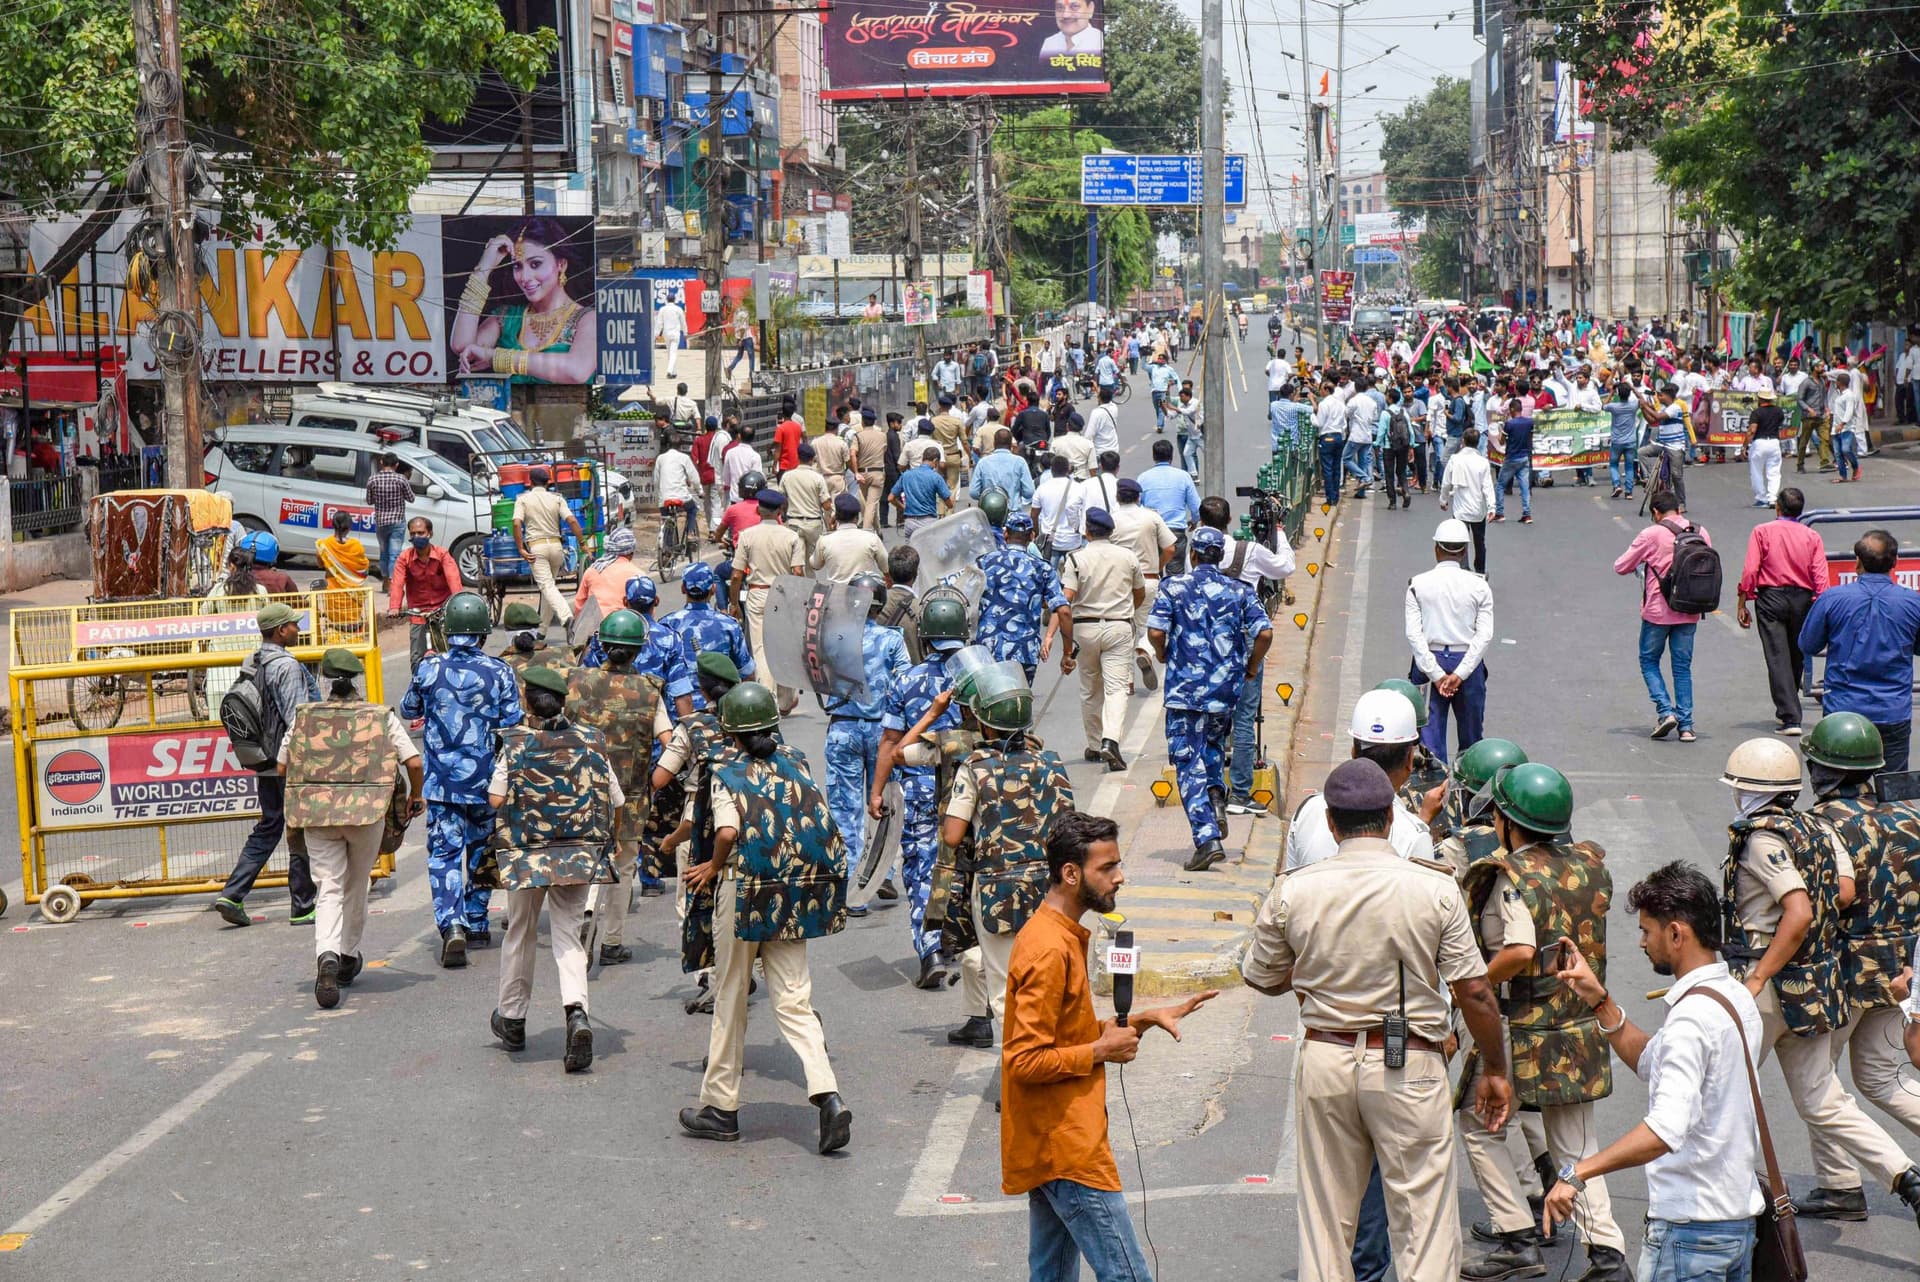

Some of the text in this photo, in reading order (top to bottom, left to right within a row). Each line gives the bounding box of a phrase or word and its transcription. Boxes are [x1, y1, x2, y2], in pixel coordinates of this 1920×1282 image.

[913, 51, 990, 66] विचार मंच
[615, 67, 626, 106] Nikon
[598, 288, 644, 313] PATNA
[606, 319, 635, 344] ONE
[352, 350, 374, 376] &
[385, 350, 439, 376] CO.
[602, 350, 640, 375] MALL
[282, 498, 320, 514] कोतवाली
[288, 511, 311, 524] थाना
[89, 624, 149, 640] PATNA
[155, 620, 229, 637] TRAFFIC
[805, 592, 825, 684] POLICE
[147, 736, 244, 776] SER
[48, 770, 101, 785] इंडियनऑयल
[118, 778, 248, 802] WORLD-CLASS
[51, 804, 103, 817] IndianOil
[114, 797, 261, 819] THE SCIENCE O
